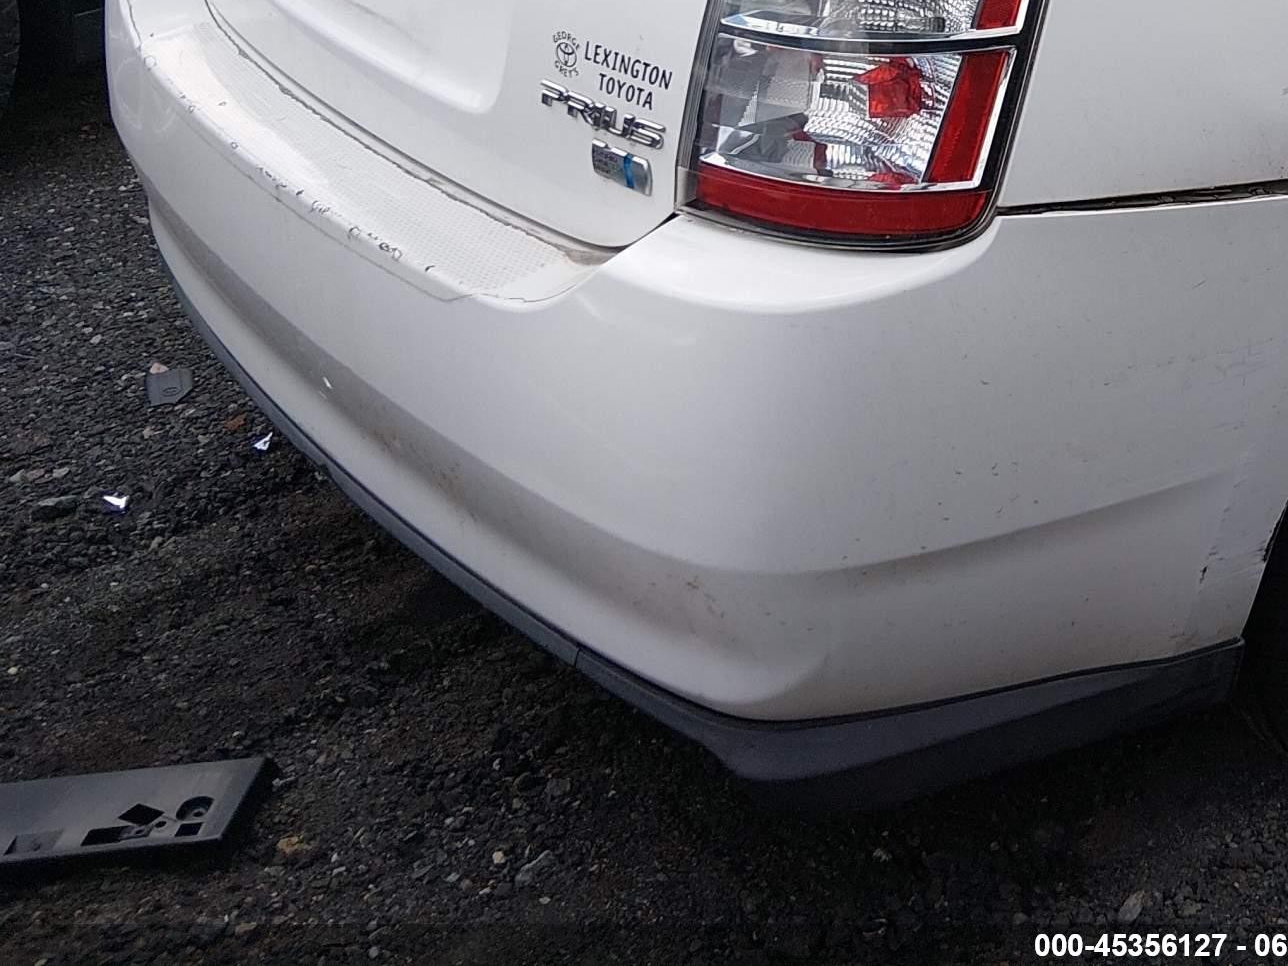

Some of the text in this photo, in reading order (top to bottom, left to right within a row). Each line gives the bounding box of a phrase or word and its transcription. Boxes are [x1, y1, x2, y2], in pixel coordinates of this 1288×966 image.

[584, 41, 673, 90] LEXINGTON
[540, 78, 667, 150] PRIUS
[599, 72, 653, 111] TOYOTA
